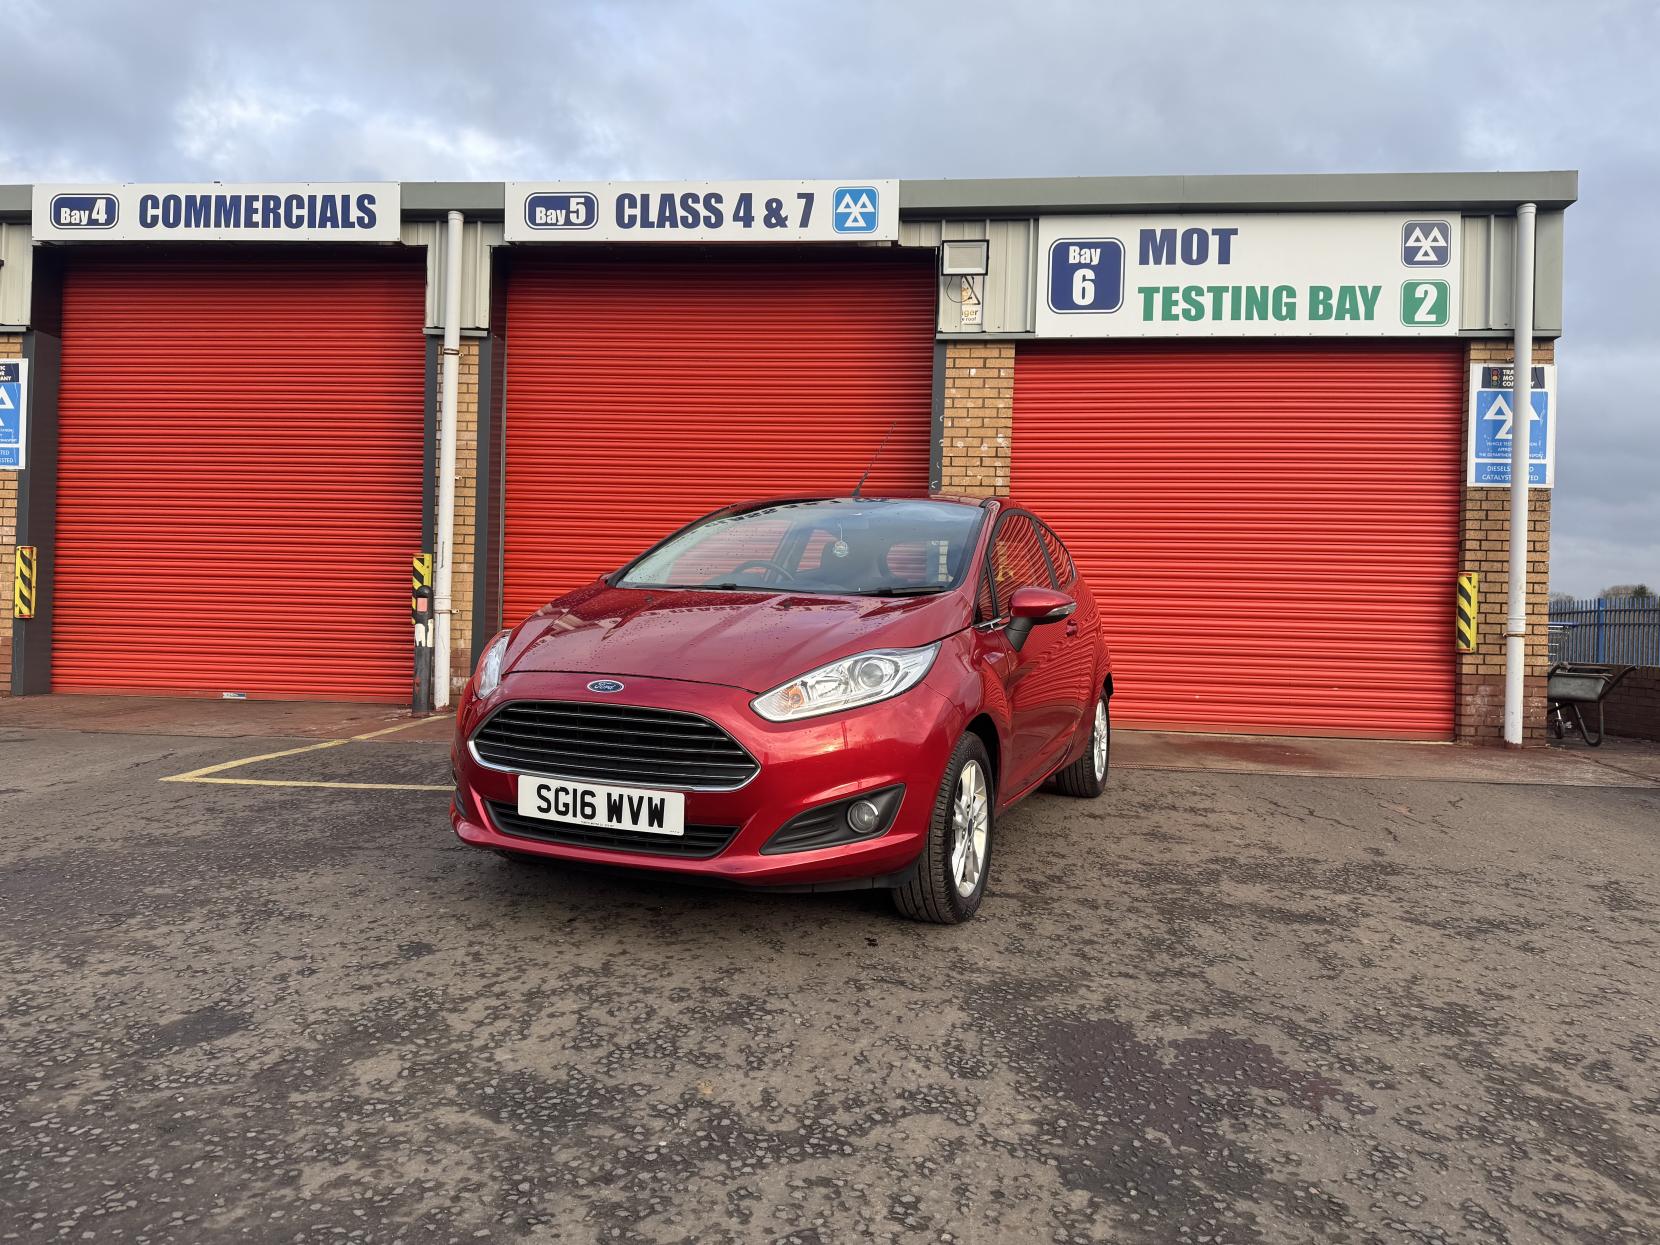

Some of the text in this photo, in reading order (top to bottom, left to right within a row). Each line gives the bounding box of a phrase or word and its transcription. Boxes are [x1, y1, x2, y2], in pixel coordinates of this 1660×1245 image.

[60, 198, 108, 226] Bay 4
[139, 193, 377, 230] COMMERCIALS
[535, 197, 586, 226] Bay 5
[615, 192, 815, 230] CLASS 4 & 7
[1068, 245, 1101, 266] Bay
[1138, 227, 1239, 266] MOT
[1071, 268, 1096, 306] 6
[1137, 284, 1382, 322] TESTING BAY
[1414, 283, 1438, 322] 2
[594, 681, 618, 691] Ford
[536, 783, 665, 829] SG16 WVW
